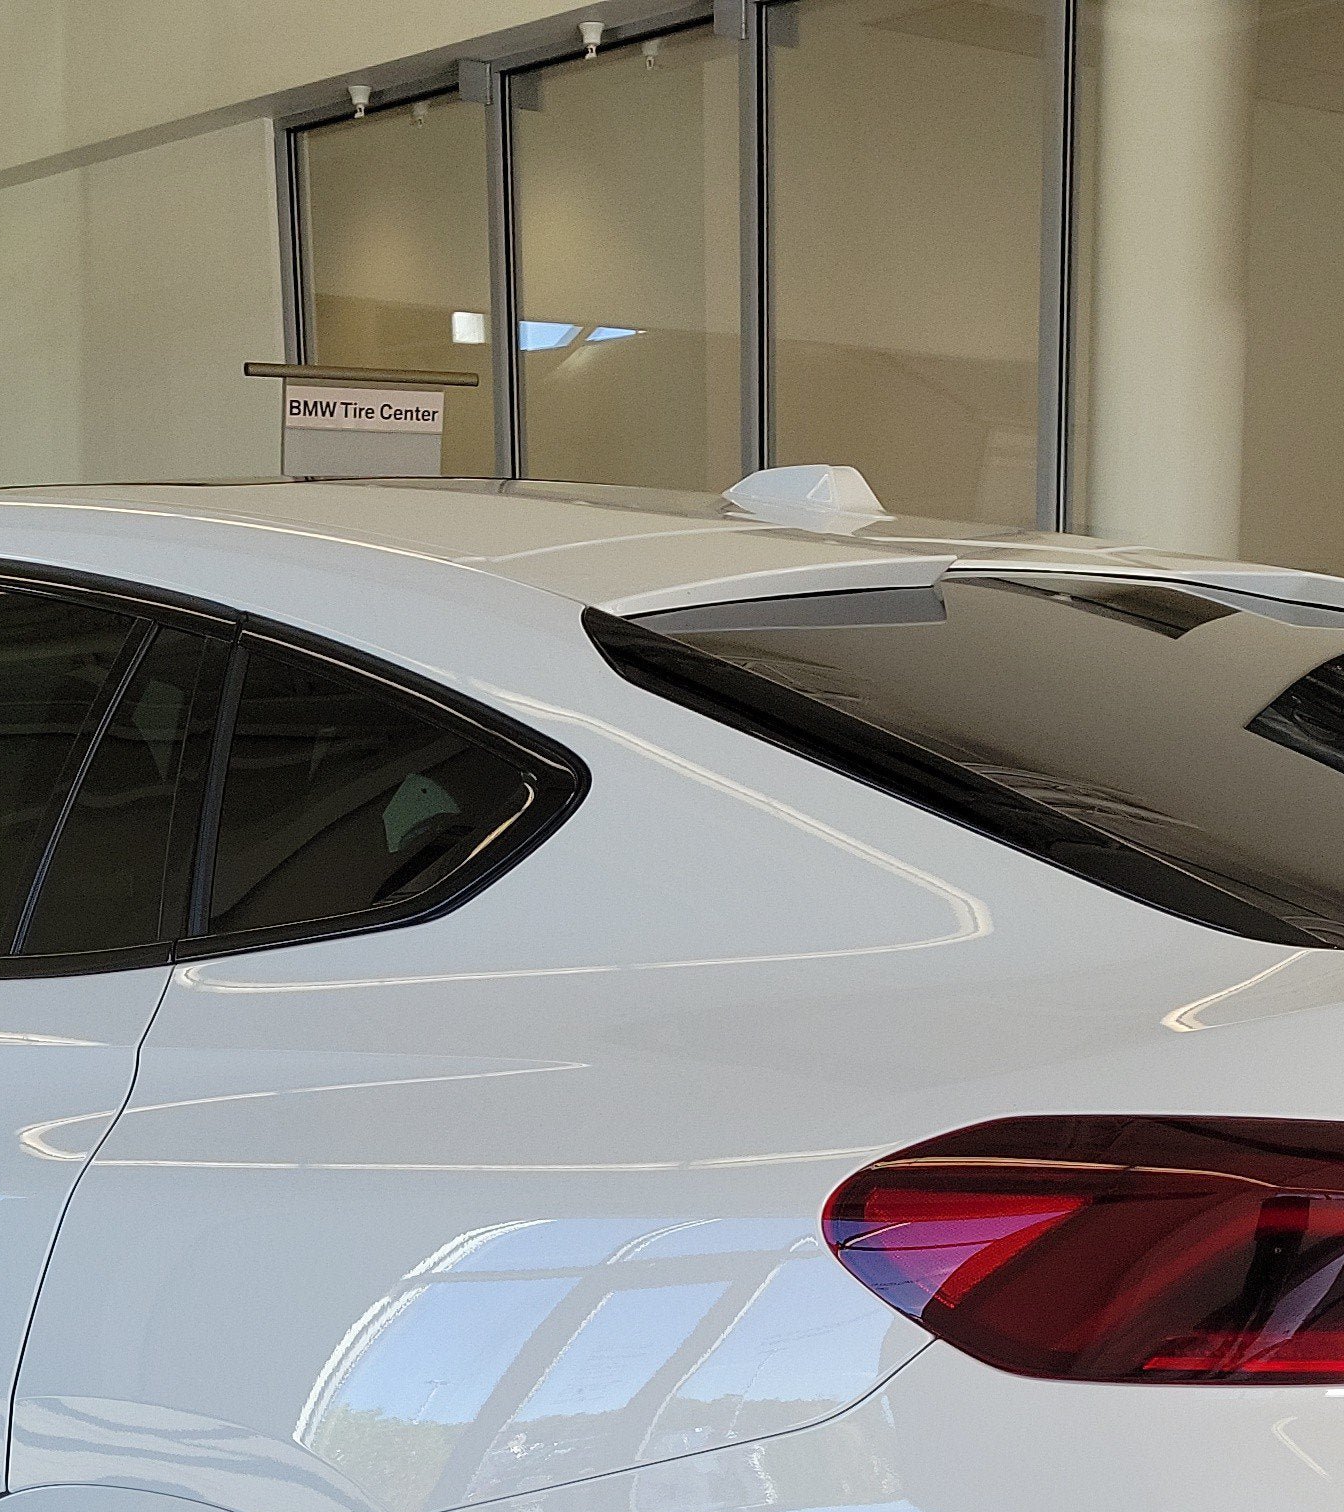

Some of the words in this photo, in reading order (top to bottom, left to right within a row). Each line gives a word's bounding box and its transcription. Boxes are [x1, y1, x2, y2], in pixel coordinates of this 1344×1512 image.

[289, 399, 337, 418] BMW
[340, 401, 375, 419] Tire
[380, 403, 439, 422] Center
